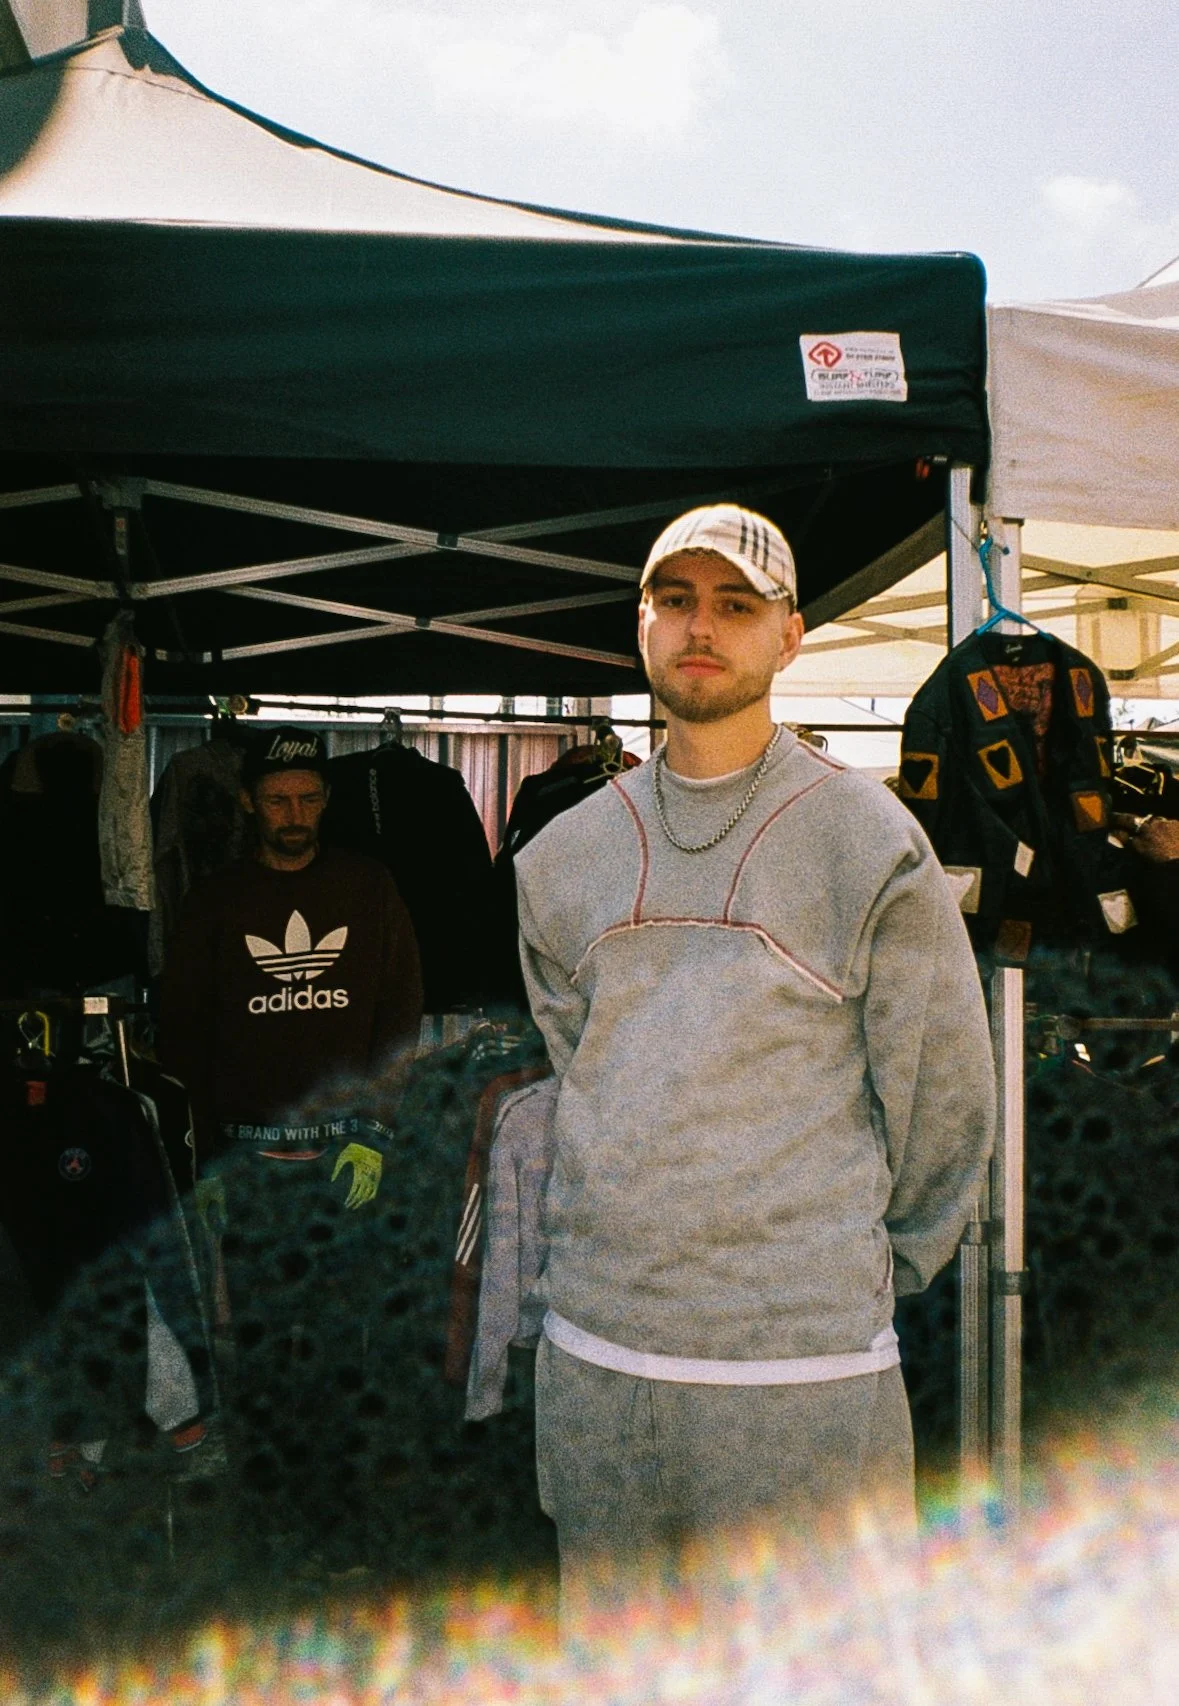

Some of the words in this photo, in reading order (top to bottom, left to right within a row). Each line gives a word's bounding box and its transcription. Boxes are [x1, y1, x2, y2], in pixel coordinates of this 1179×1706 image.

[264, 734, 319, 763] Loyal
[248, 984, 349, 1014] adidas
[238, 1124, 281, 1141] BRAND
[284, 1125, 320, 1141] WITH
[323, 1120, 347, 1138] THE
